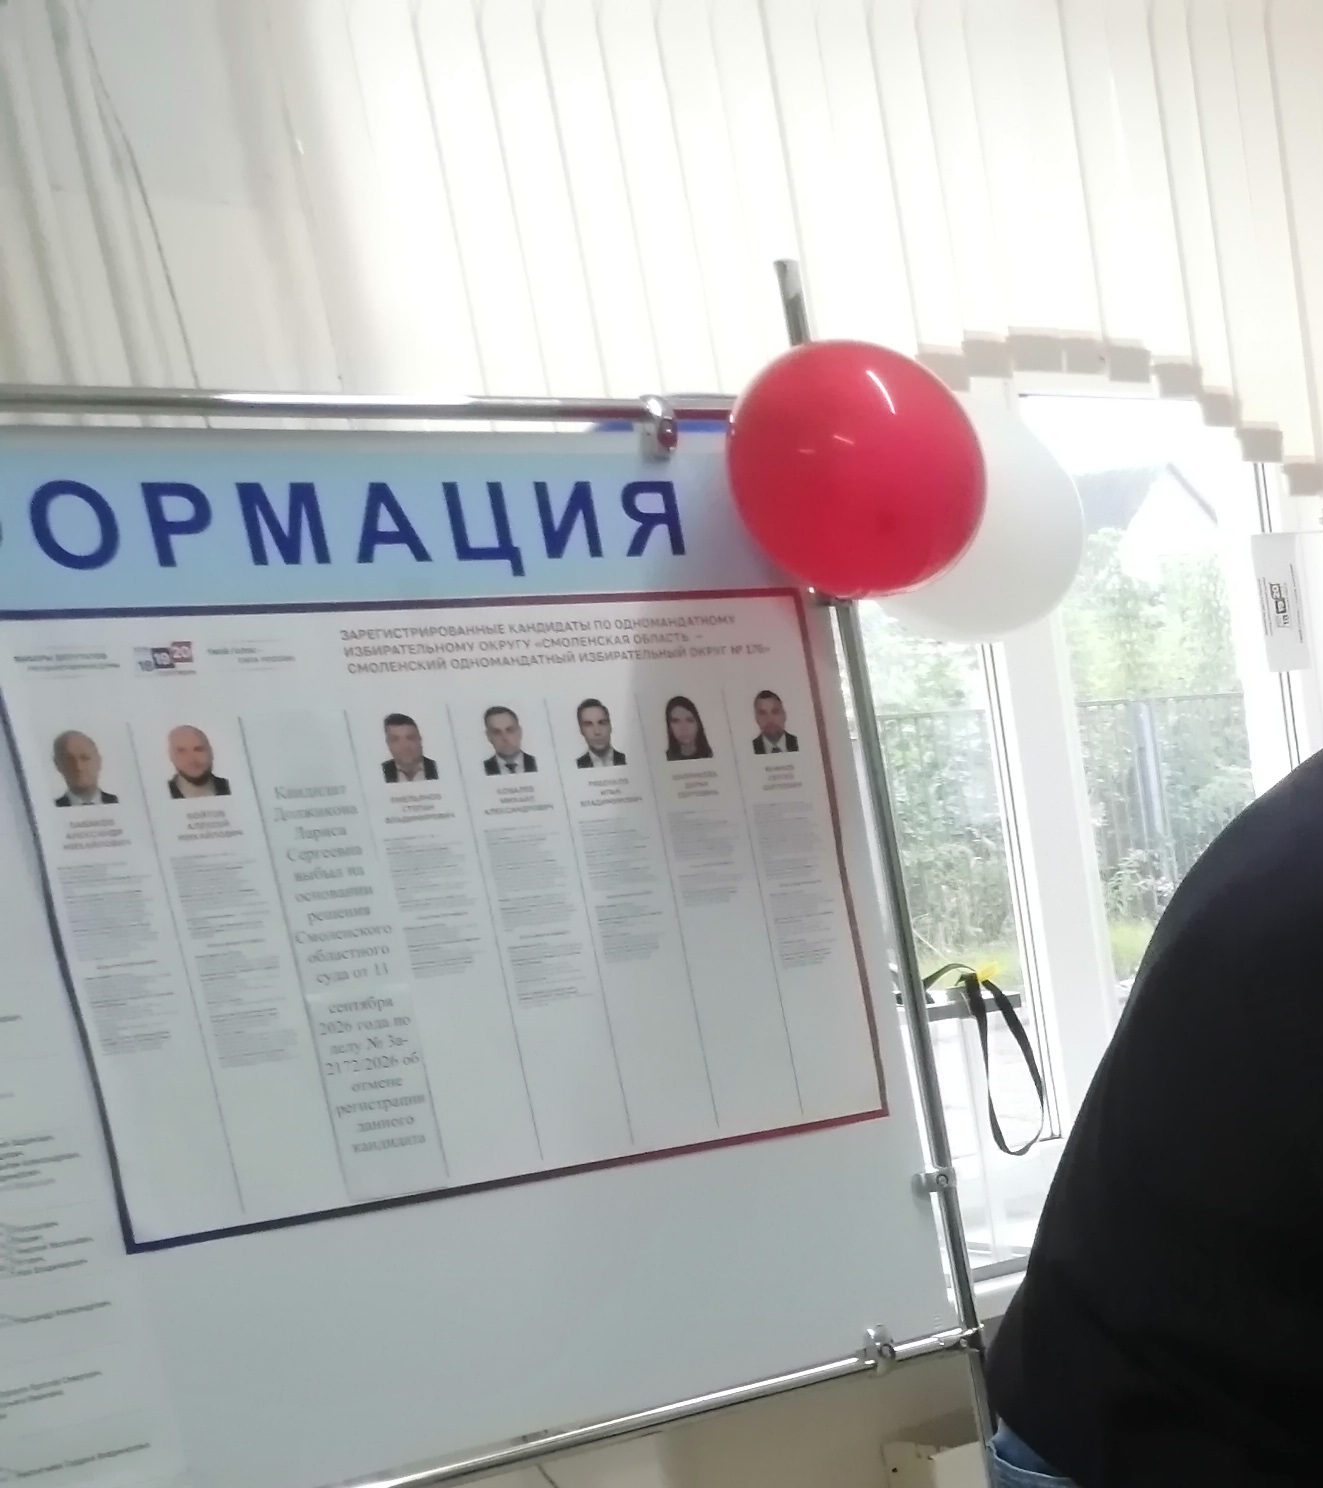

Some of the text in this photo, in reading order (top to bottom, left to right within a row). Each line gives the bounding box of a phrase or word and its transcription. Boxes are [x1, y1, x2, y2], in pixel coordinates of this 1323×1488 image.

[0, 480, 686, 577] ОРМАЦИЯ
[340, 614, 735, 641] ЗАРЕГИСТРИРОВАННЫЕ КАНДИДАТЫ ПО ОДНОМАНДАТНОМУ
[344, 642, 475, 658] ИЗБИРАТЕЛЬНОМУ
[479, 639, 531, 652] ОКРУГУ
[634, 632, 690, 645] ОБЛАСТЬ
[348, 656, 447, 674] СМОЛЕНСКИЙ
[450, 651, 576, 671] ОДНОМАНДАТНЫЙ
[579, 645, 687, 663] ИЗБИРАТЕЛЬНЫЙ
[690, 645, 726, 657] ОКРУГ
[295, 924, 393, 944] Смоленского
[307, 944, 391, 963] областного
[352, 967, 369, 980] от
[336, 1094, 426, 1119] регистрации
